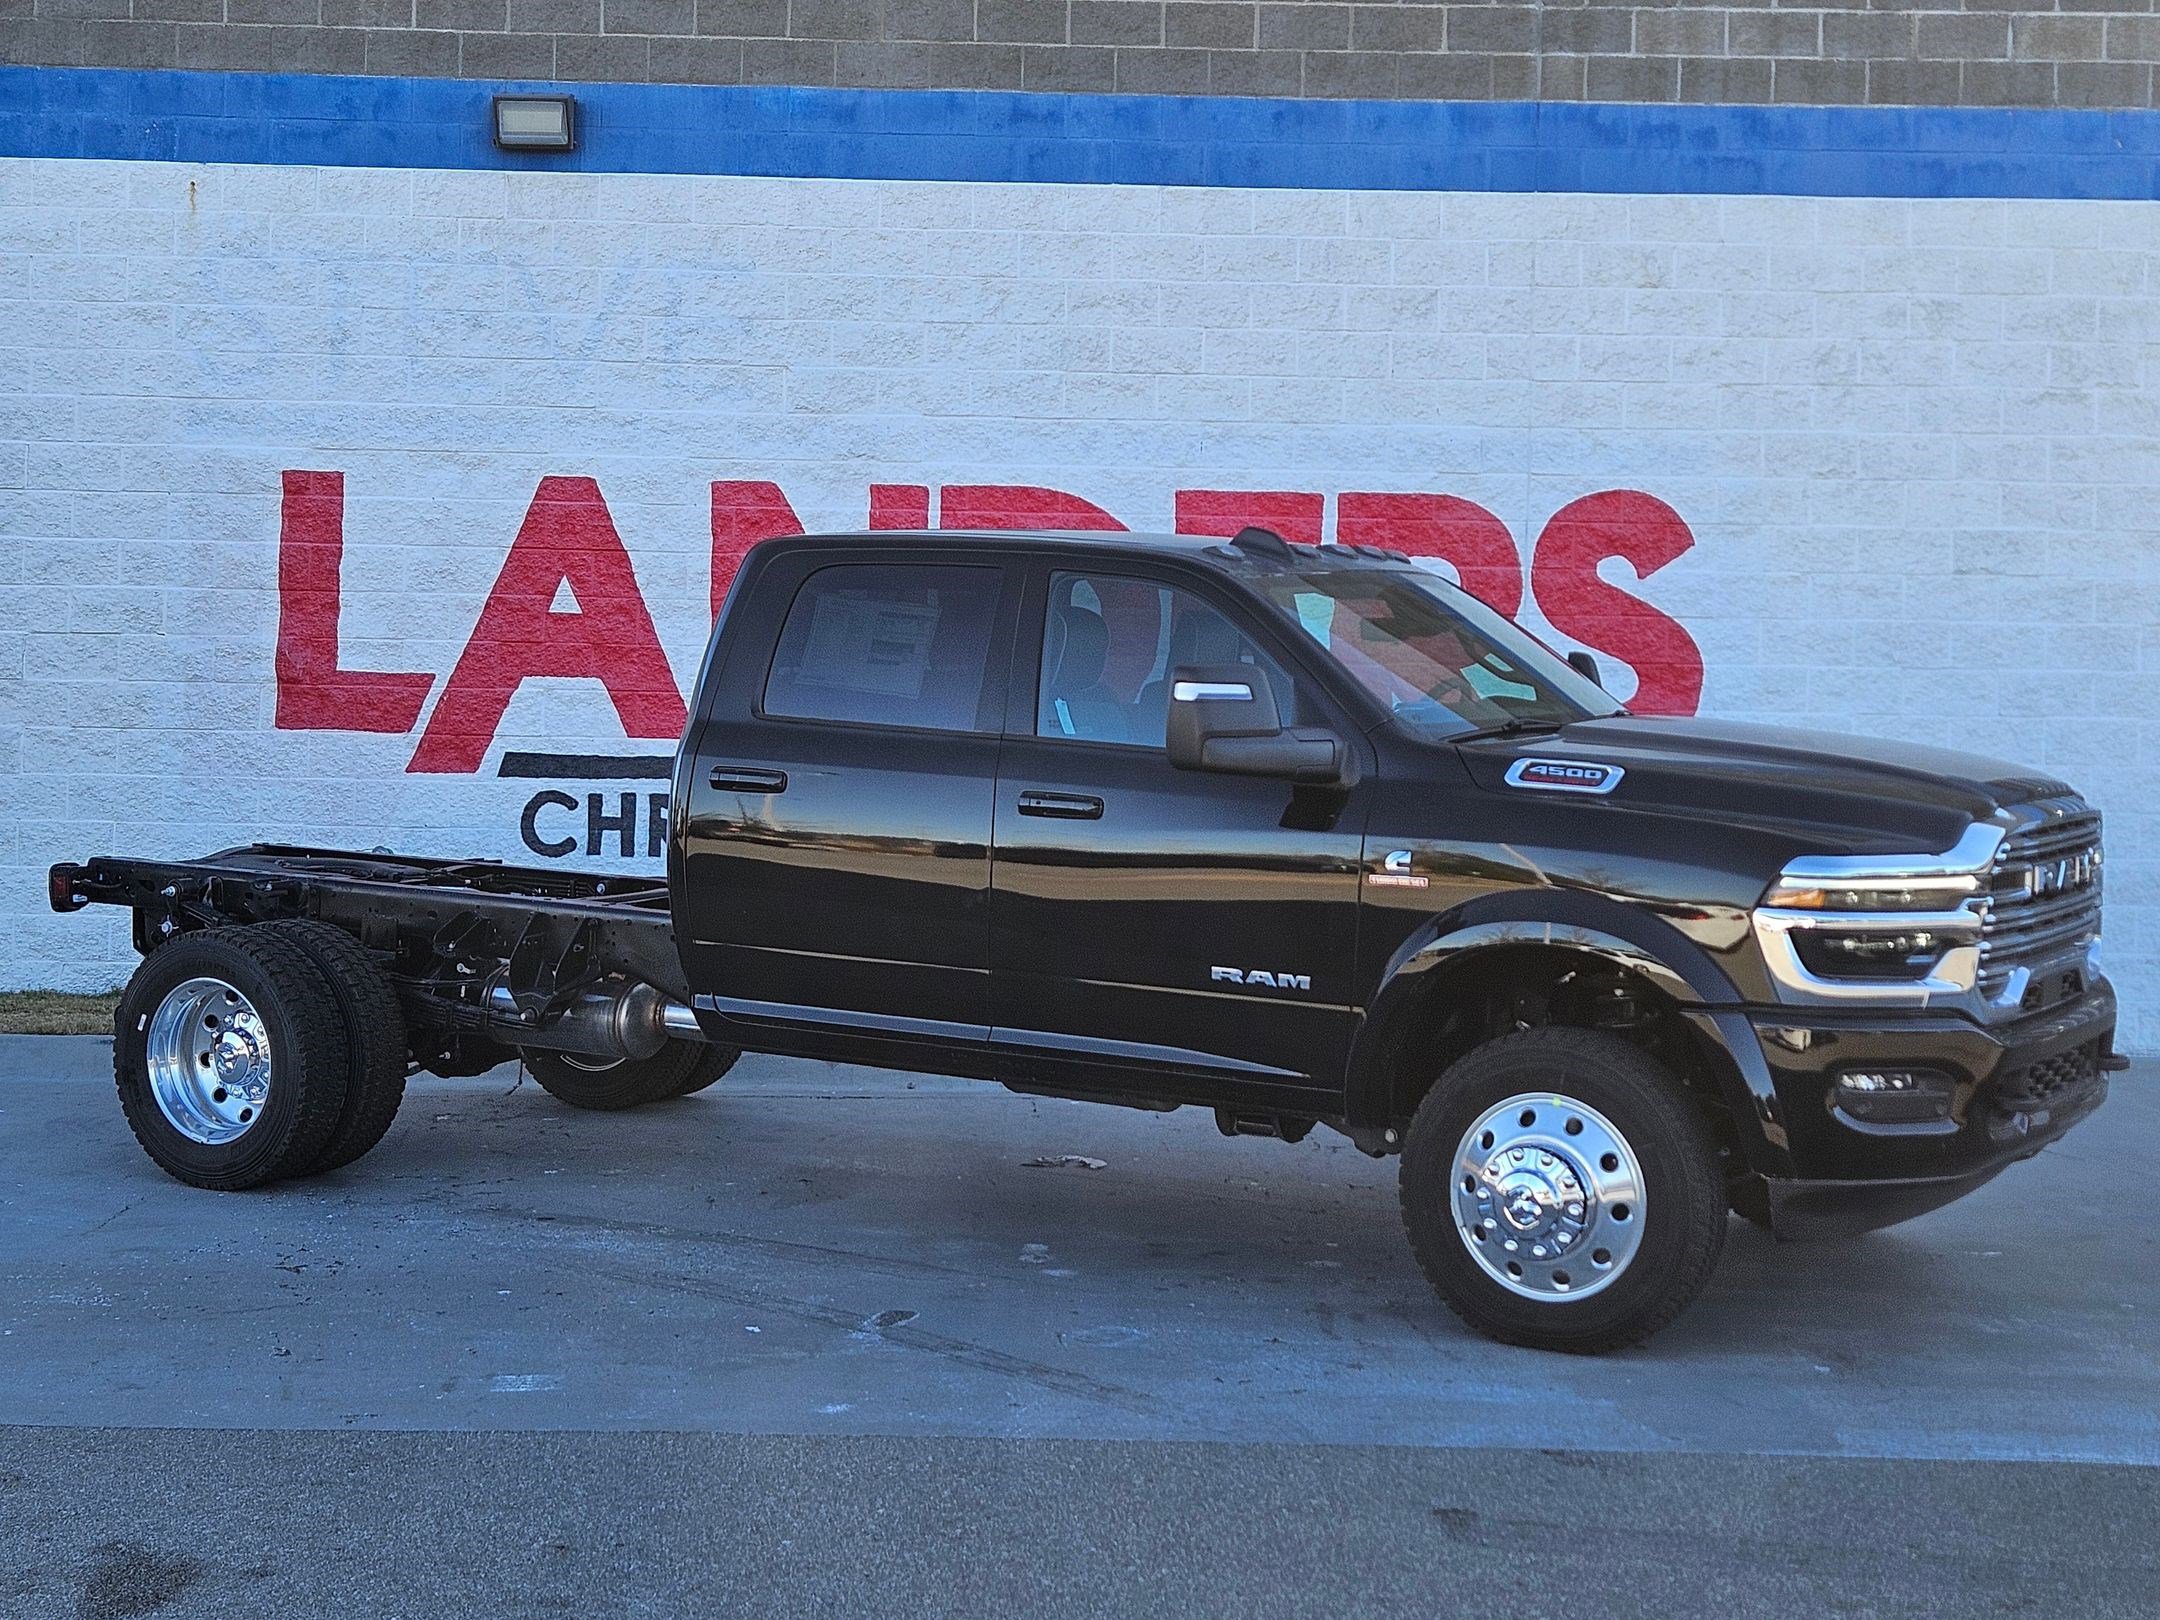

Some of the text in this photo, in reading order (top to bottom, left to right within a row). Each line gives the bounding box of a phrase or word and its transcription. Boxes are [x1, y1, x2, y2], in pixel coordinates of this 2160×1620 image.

[275, 470, 1703, 774] LARS
[1528, 765, 1602, 779] 4500
[1210, 965, 1311, 991] RAM
